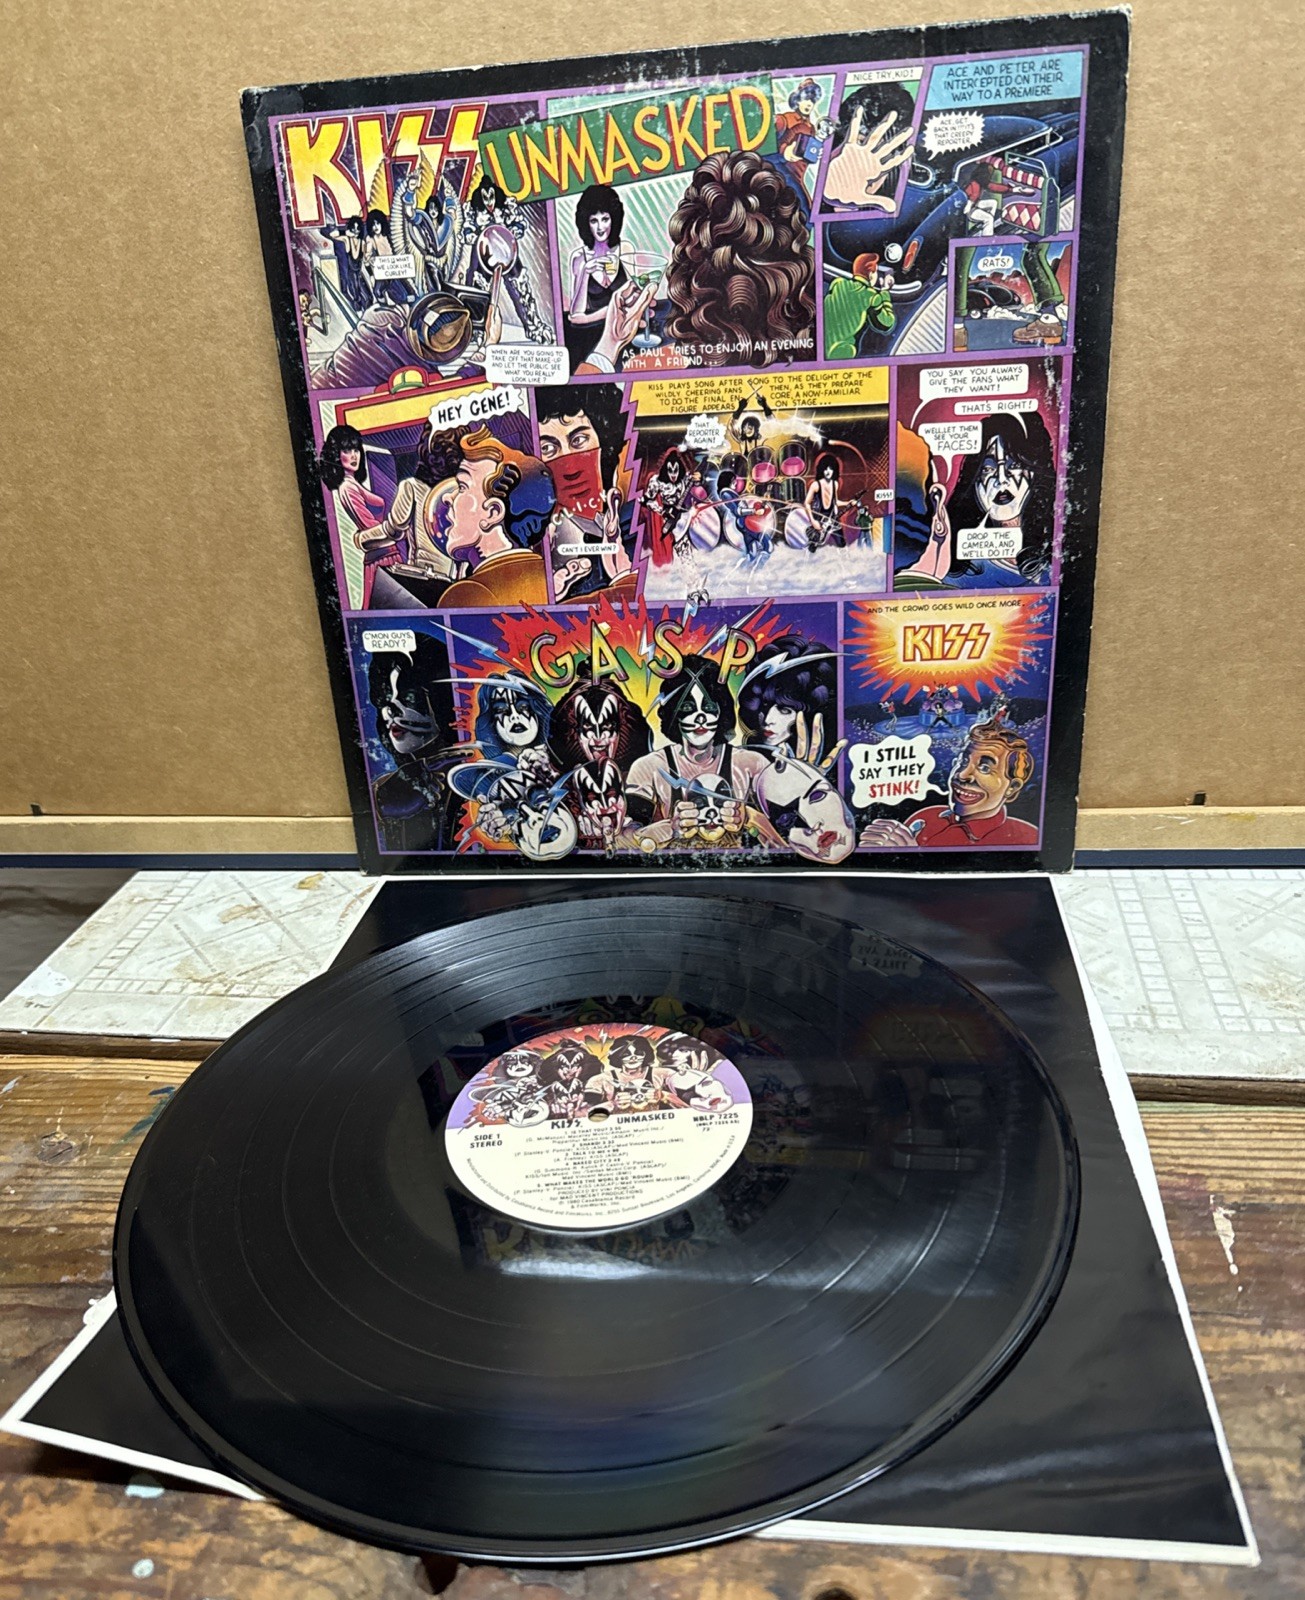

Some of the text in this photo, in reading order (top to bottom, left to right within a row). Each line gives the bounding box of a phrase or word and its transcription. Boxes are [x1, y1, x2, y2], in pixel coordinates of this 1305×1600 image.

[947, 58, 1061, 78] ACE AND PETER ARE
[853, 72, 873, 82] NICE
[944, 71, 1064, 91] INTERCEPTED ON THEIR
[951, 84, 1053, 102] WAY TO A PREMIERE
[278, 86, 771, 229] KISS UNMASKED
[982, 258, 1010, 268] RATS!
[622, 338, 815, 359] AS PAUL TRIES TO ENJOY AN EVENING
[622, 359, 647, 369] WITH
[654, 358, 662, 367] A
[535, 370, 556, 378] REALLY
[926, 370, 944, 378] YOU
[970, 368, 988, 376] YOU
[991, 366, 1023, 374] ALWAYS
[648, 383, 664, 391] KISS
[668, 382, 691, 390] PLAYS
[694, 380, 715, 388] SONG
[719, 378, 743, 387] AFTER
[772, 376, 784, 384] TO
[787, 374, 804, 383] THE
[805, 373, 838, 382] DELIGHT
[842, 371, 854, 380] OF
[857, 370, 873, 379] THE
[928, 378, 947, 386] GIVE
[971, 376, 993, 384] FANS
[996, 374, 1020, 382] WHAT
[655, 391, 681, 399] WILDLY
[685, 388, 721, 397] CHEERING
[831, 380, 863, 388] PREPARE
[944, 385, 964, 394] THEY
[660, 398, 670, 406] TO
[684, 396, 700, 404] THE
[703, 395, 726, 403] FINAL
[795, 391, 801, 399] A
[802, 388, 861, 398] NOW-FAMILIAR
[438, 391, 510, 424] HEY GENE!
[671, 404, 698, 413] FIGURE
[702, 402, 736, 411] APPEARS
[775, 400, 788, 408] ON
[961, 400, 1032, 413] THAT'S RIGHT!
[949, 432, 969, 440] YOUR
[937, 440, 977, 452] FACES!
[966, 531, 1011, 541] DROP THE
[999, 539, 1015, 548] AND
[962, 550, 984, 558] WE'LL
[987, 549, 1000, 557] DO
[867, 605, 883, 614] AND
[885, 605, 899, 613] THE
[902, 603, 930, 612] CROWD
[932, 602, 953, 611] GOES
[976, 600, 997, 609] ONCE
[364, 631, 389, 640] C'MON
[371, 639, 407, 649] READY?
[902, 622, 992, 663] KISS
[529, 618, 758, 688] GASP
[864, 745, 916, 763] I STILL
[859, 762, 926, 780] SAY THEY
[868, 780, 921, 799] STINK!
[551, 1119, 582, 1129] KISS
[617, 1112, 675, 1124] UNMASKED
[470, 1140, 503, 1149] STEREO
